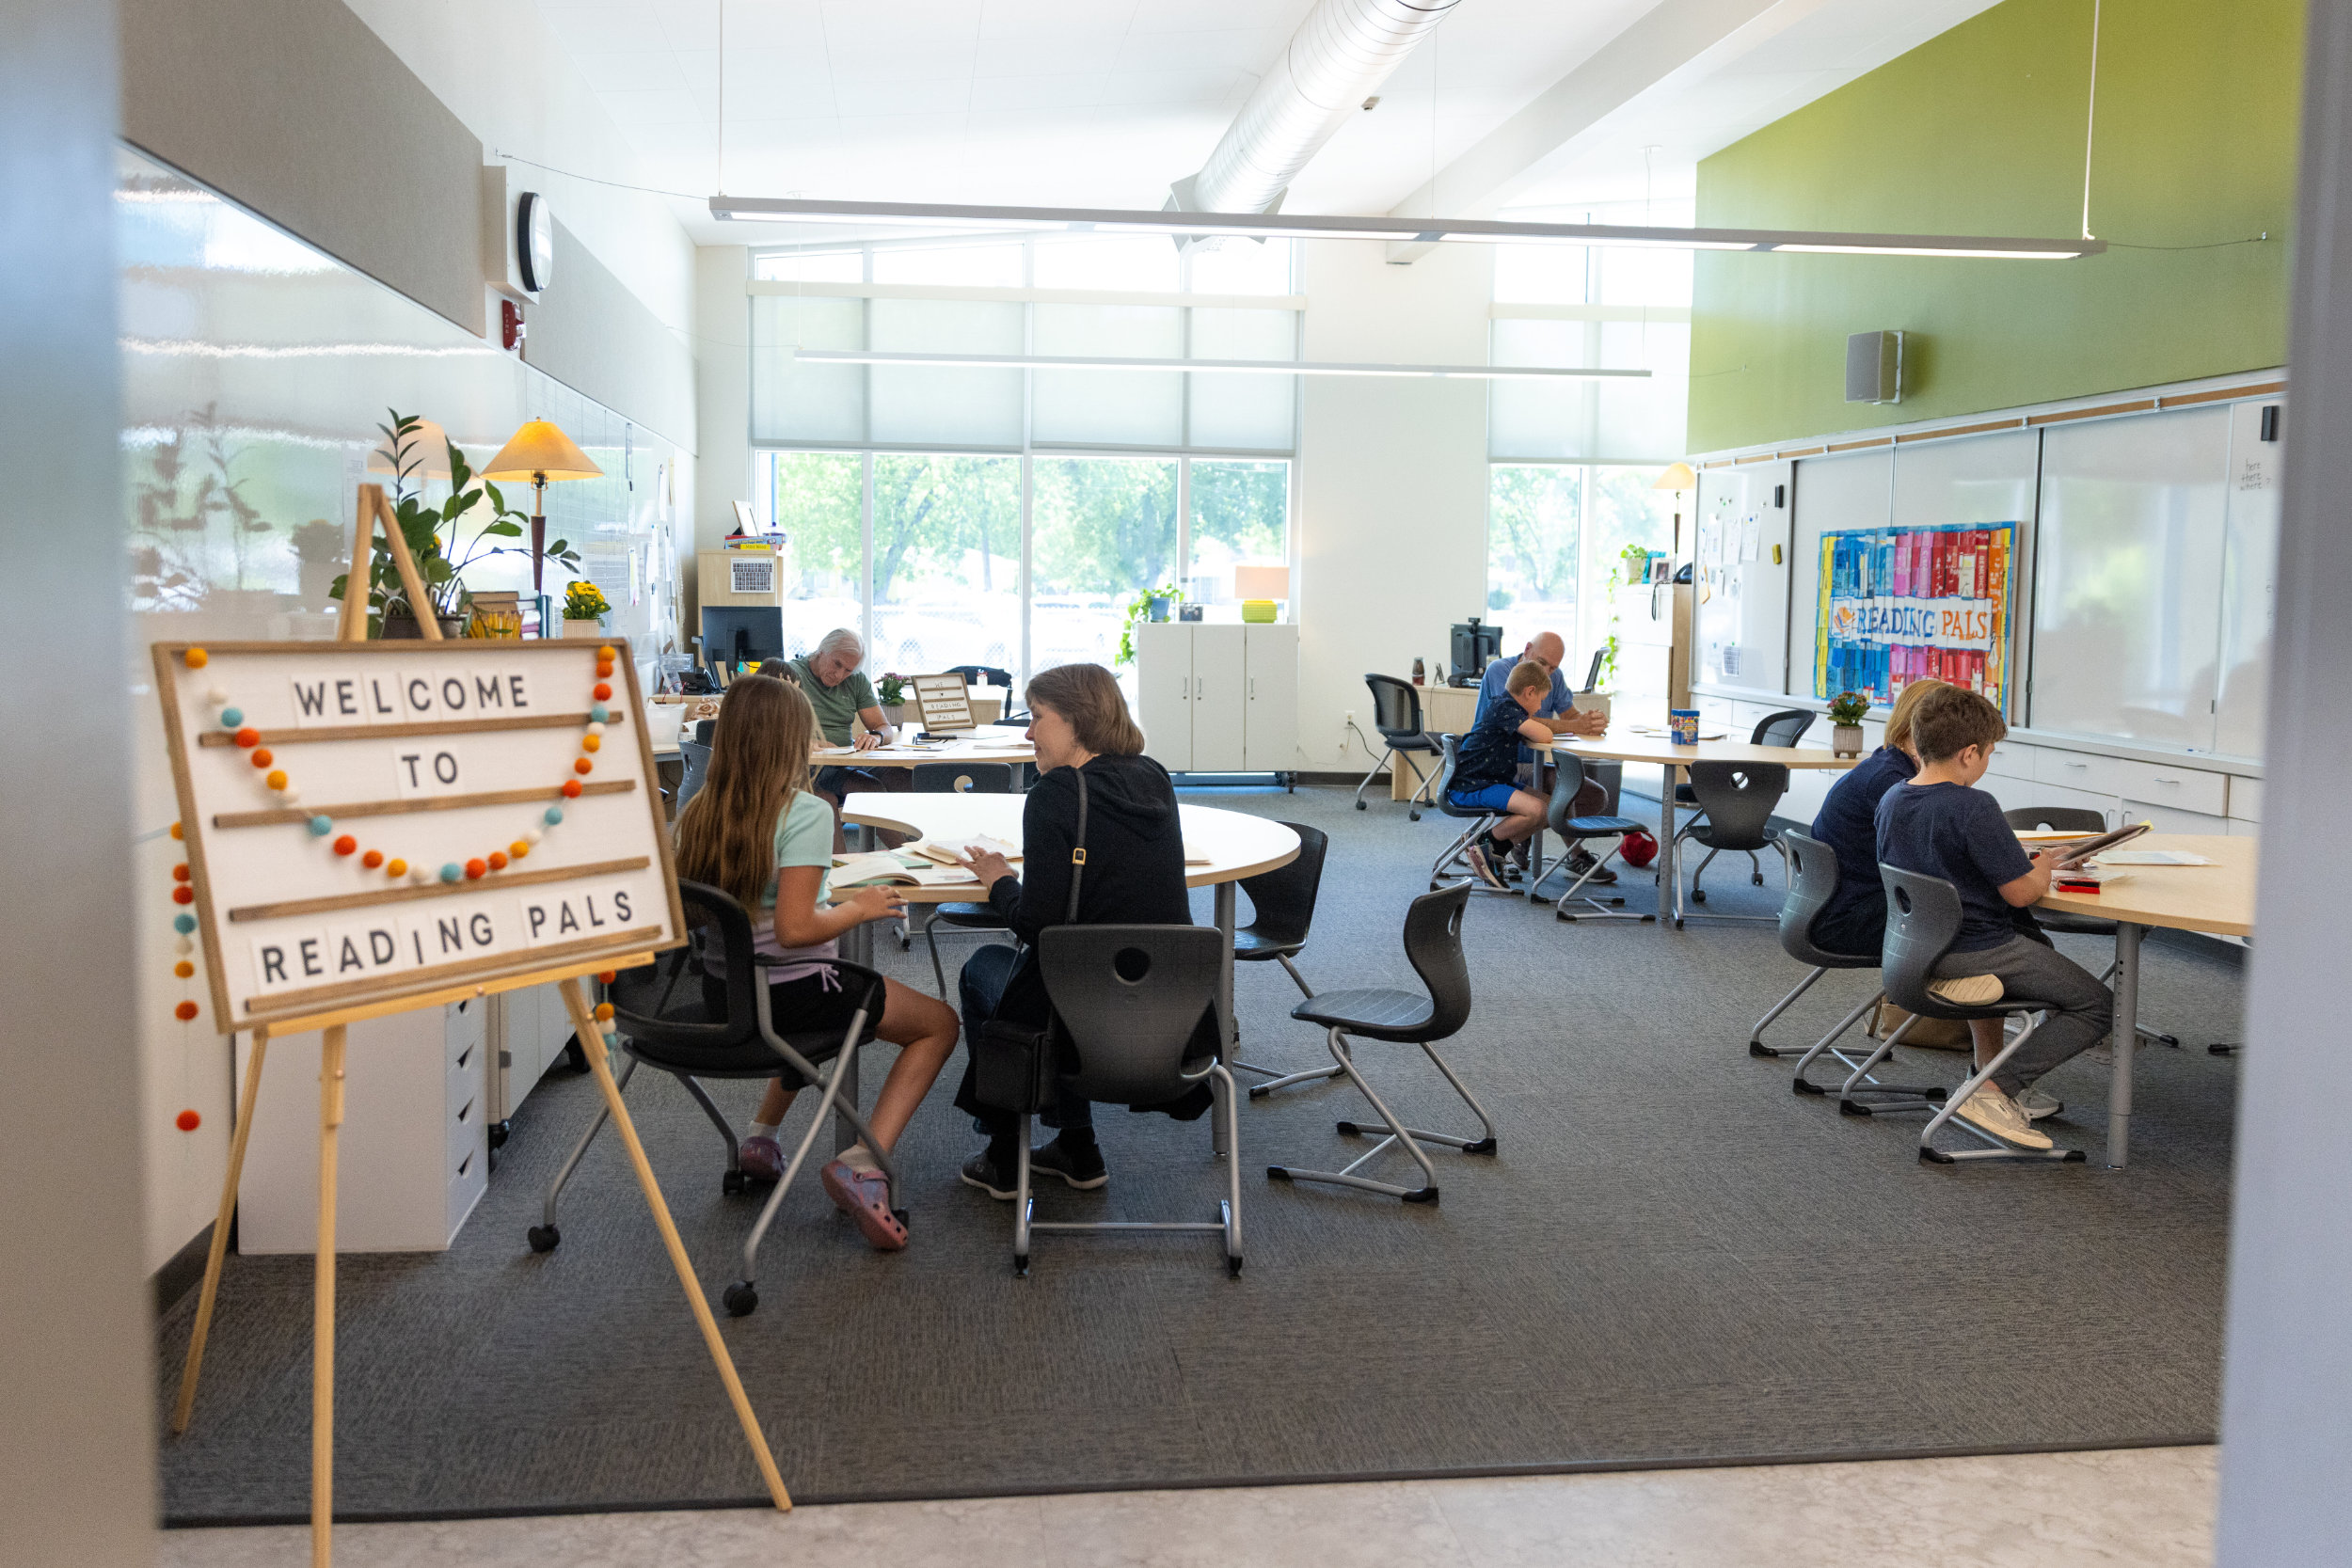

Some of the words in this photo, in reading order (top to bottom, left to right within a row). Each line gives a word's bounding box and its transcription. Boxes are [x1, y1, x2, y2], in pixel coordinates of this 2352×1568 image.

[1857, 607, 1935, 638] READING
[1942, 610, 1987, 641] PALS
[294, 675, 528, 716] WELCOME
[402, 752, 458, 787] TO
[262, 912, 493, 983] READING
[528, 891, 632, 938] PALS
